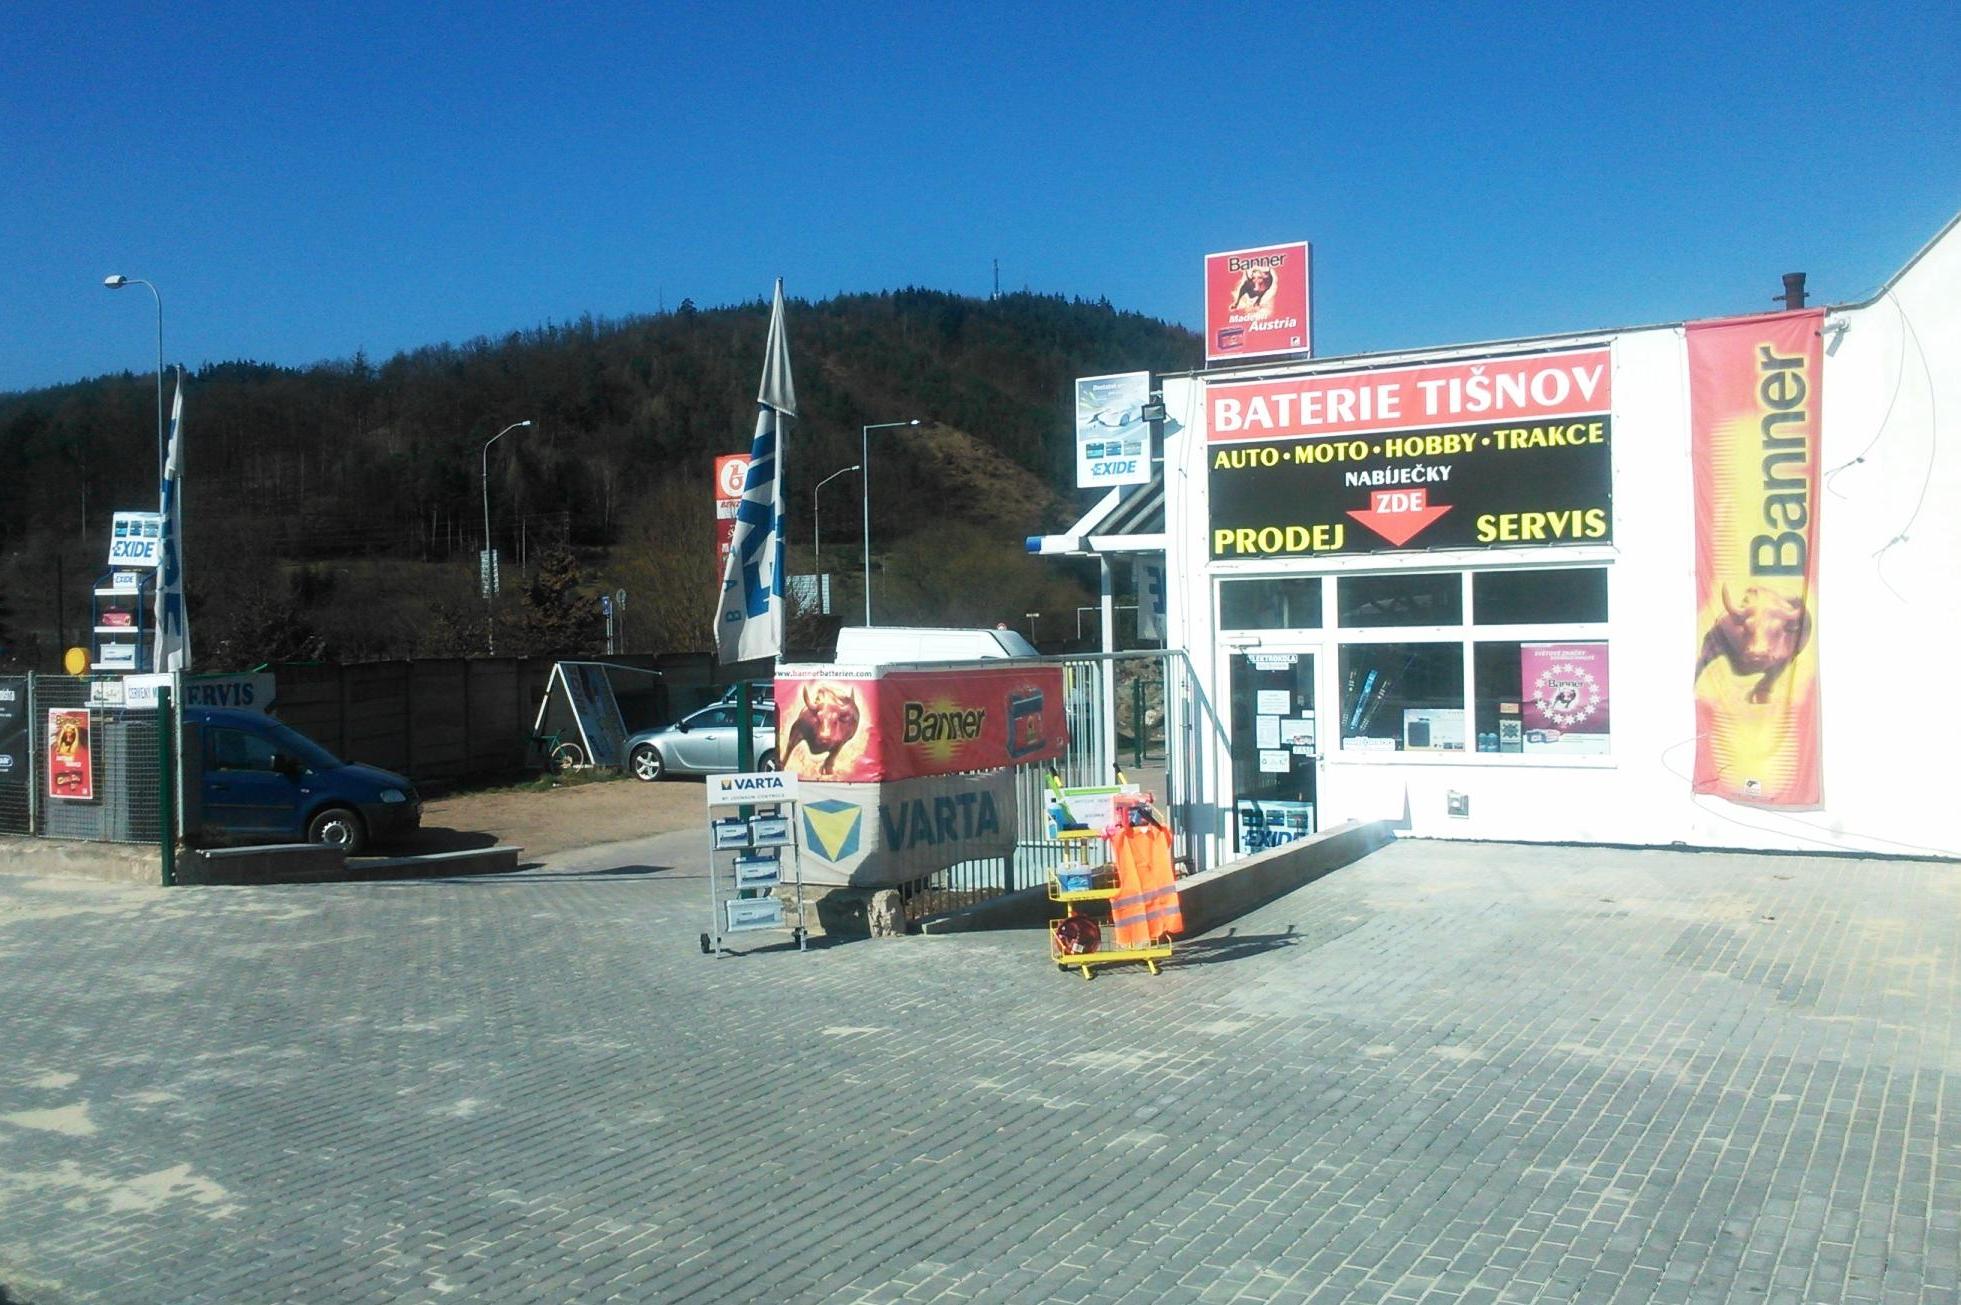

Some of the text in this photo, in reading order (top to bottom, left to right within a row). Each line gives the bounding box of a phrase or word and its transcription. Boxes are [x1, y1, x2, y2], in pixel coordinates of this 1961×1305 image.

[1229, 254, 1287, 272] Banner
[1249, 316, 1297, 332] Austria
[1215, 364, 1604, 432] BATERIE TIŠNOV
[1214, 423, 1604, 469] AUTO MOTO HOBBY TRAKCE
[1091, 461, 1137, 476] EXIDE
[1750, 345, 1807, 578] Banner
[1345, 464, 1452, 488] NABÍJEČKY
[1376, 492, 1424, 514] ZDE
[1214, 508, 1606, 554] PRODEJ SERVIS
[112, 540, 155, 558] EXIDE
[903, 702, 984, 744] Banner
[735, 777, 783, 789] VARTA
[880, 791, 999, 851] VARTA
